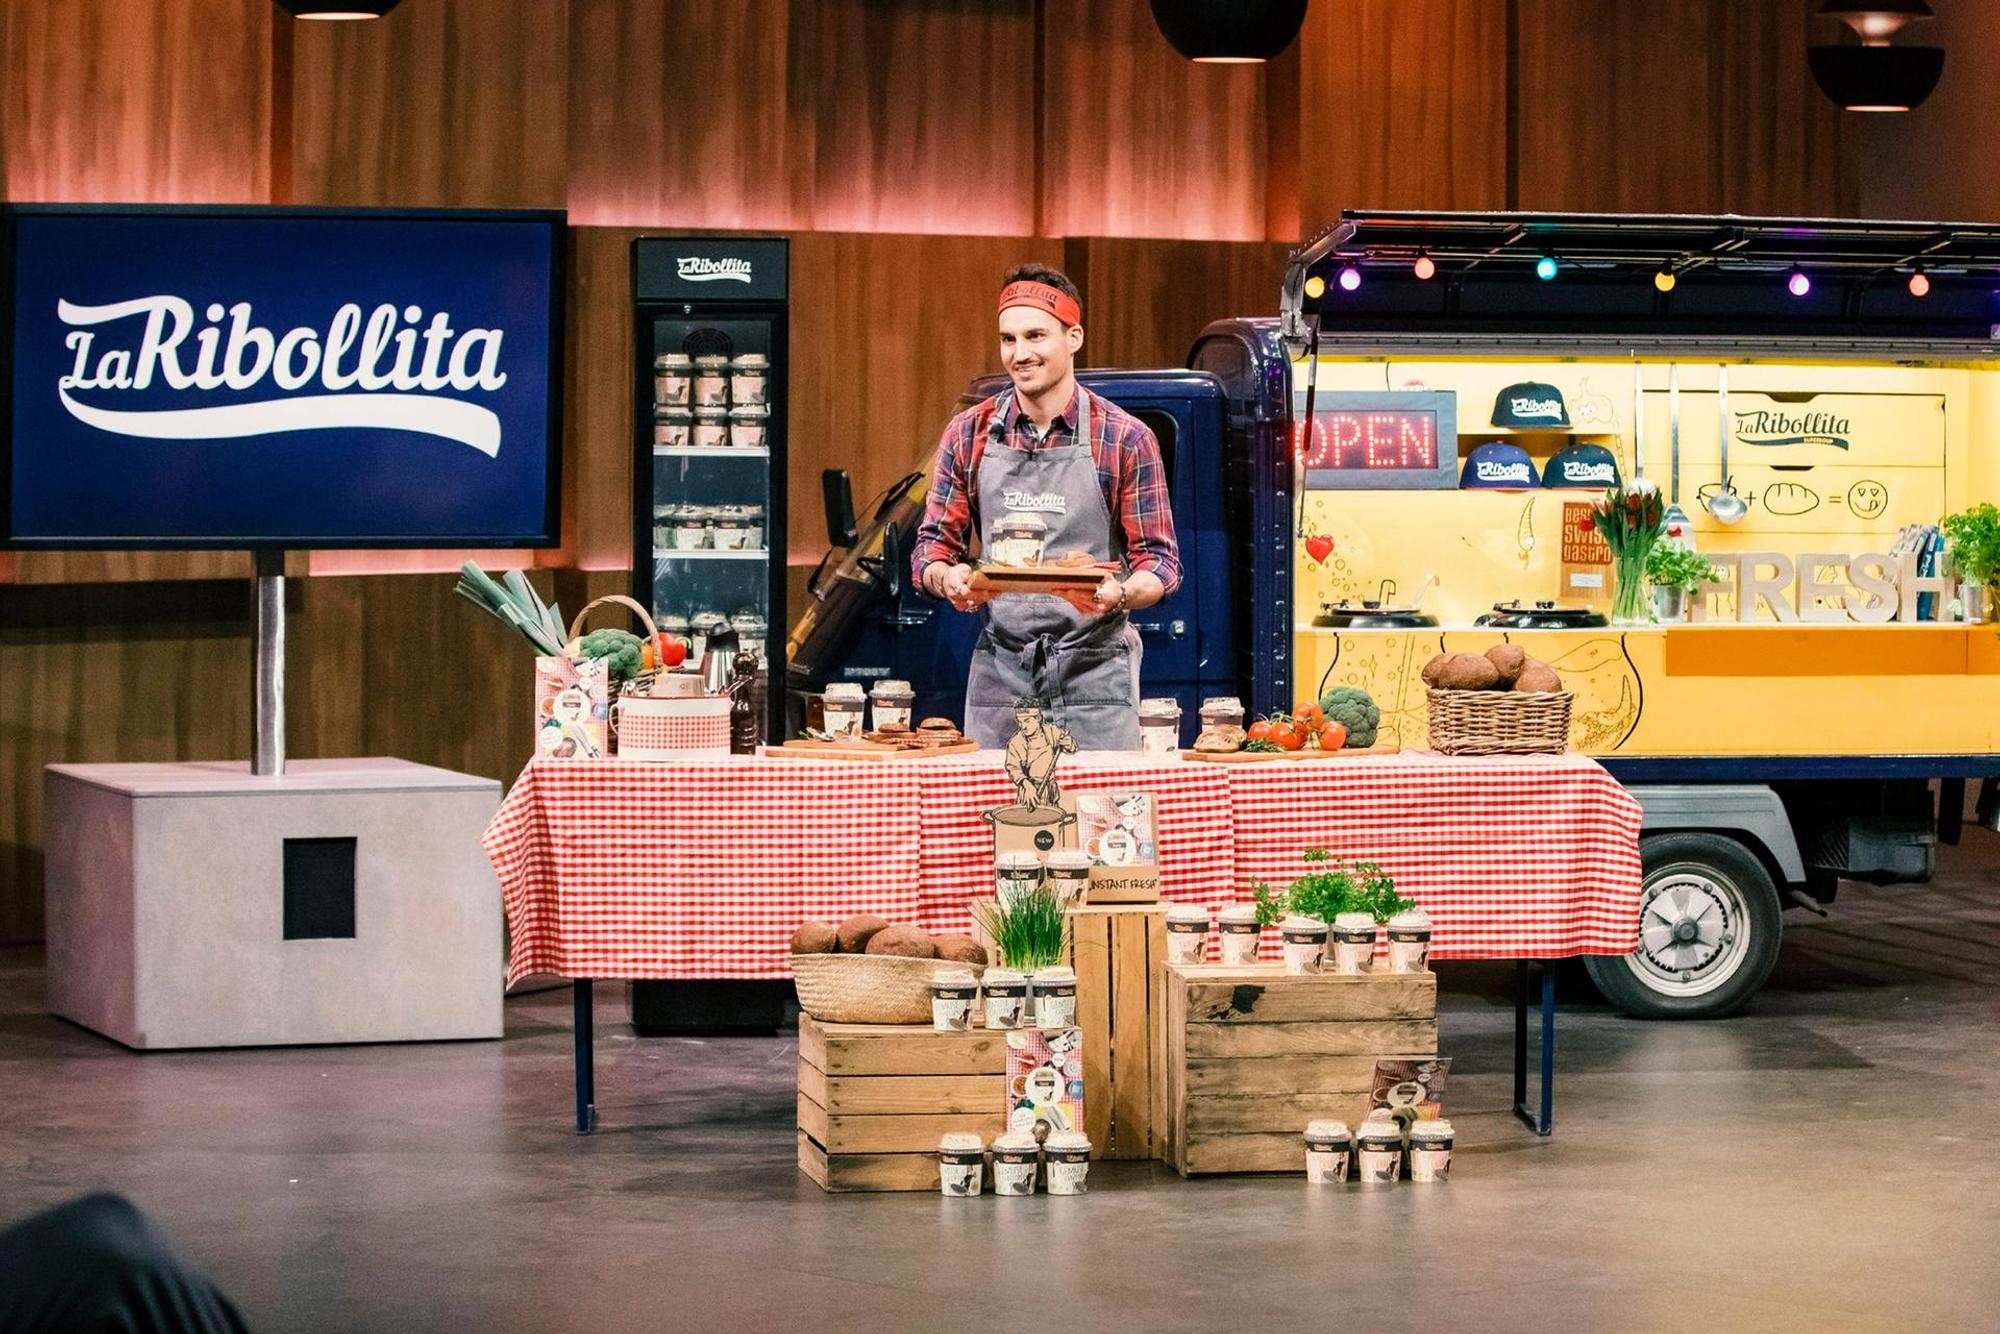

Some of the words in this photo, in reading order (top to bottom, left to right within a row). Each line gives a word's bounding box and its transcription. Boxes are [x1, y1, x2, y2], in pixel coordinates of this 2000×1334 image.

[677, 257, 752, 274] Ribollita
[58, 294, 507, 391] Ribollita
[60, 331, 132, 390] La
[1294, 415, 1431, 466] OPEN
[1735, 410, 1851, 435] Ribollita
[1736, 420, 1754, 434] La
[1003, 491, 1066, 507] Ribollita
[1687, 552, 1956, 623] FRESH
